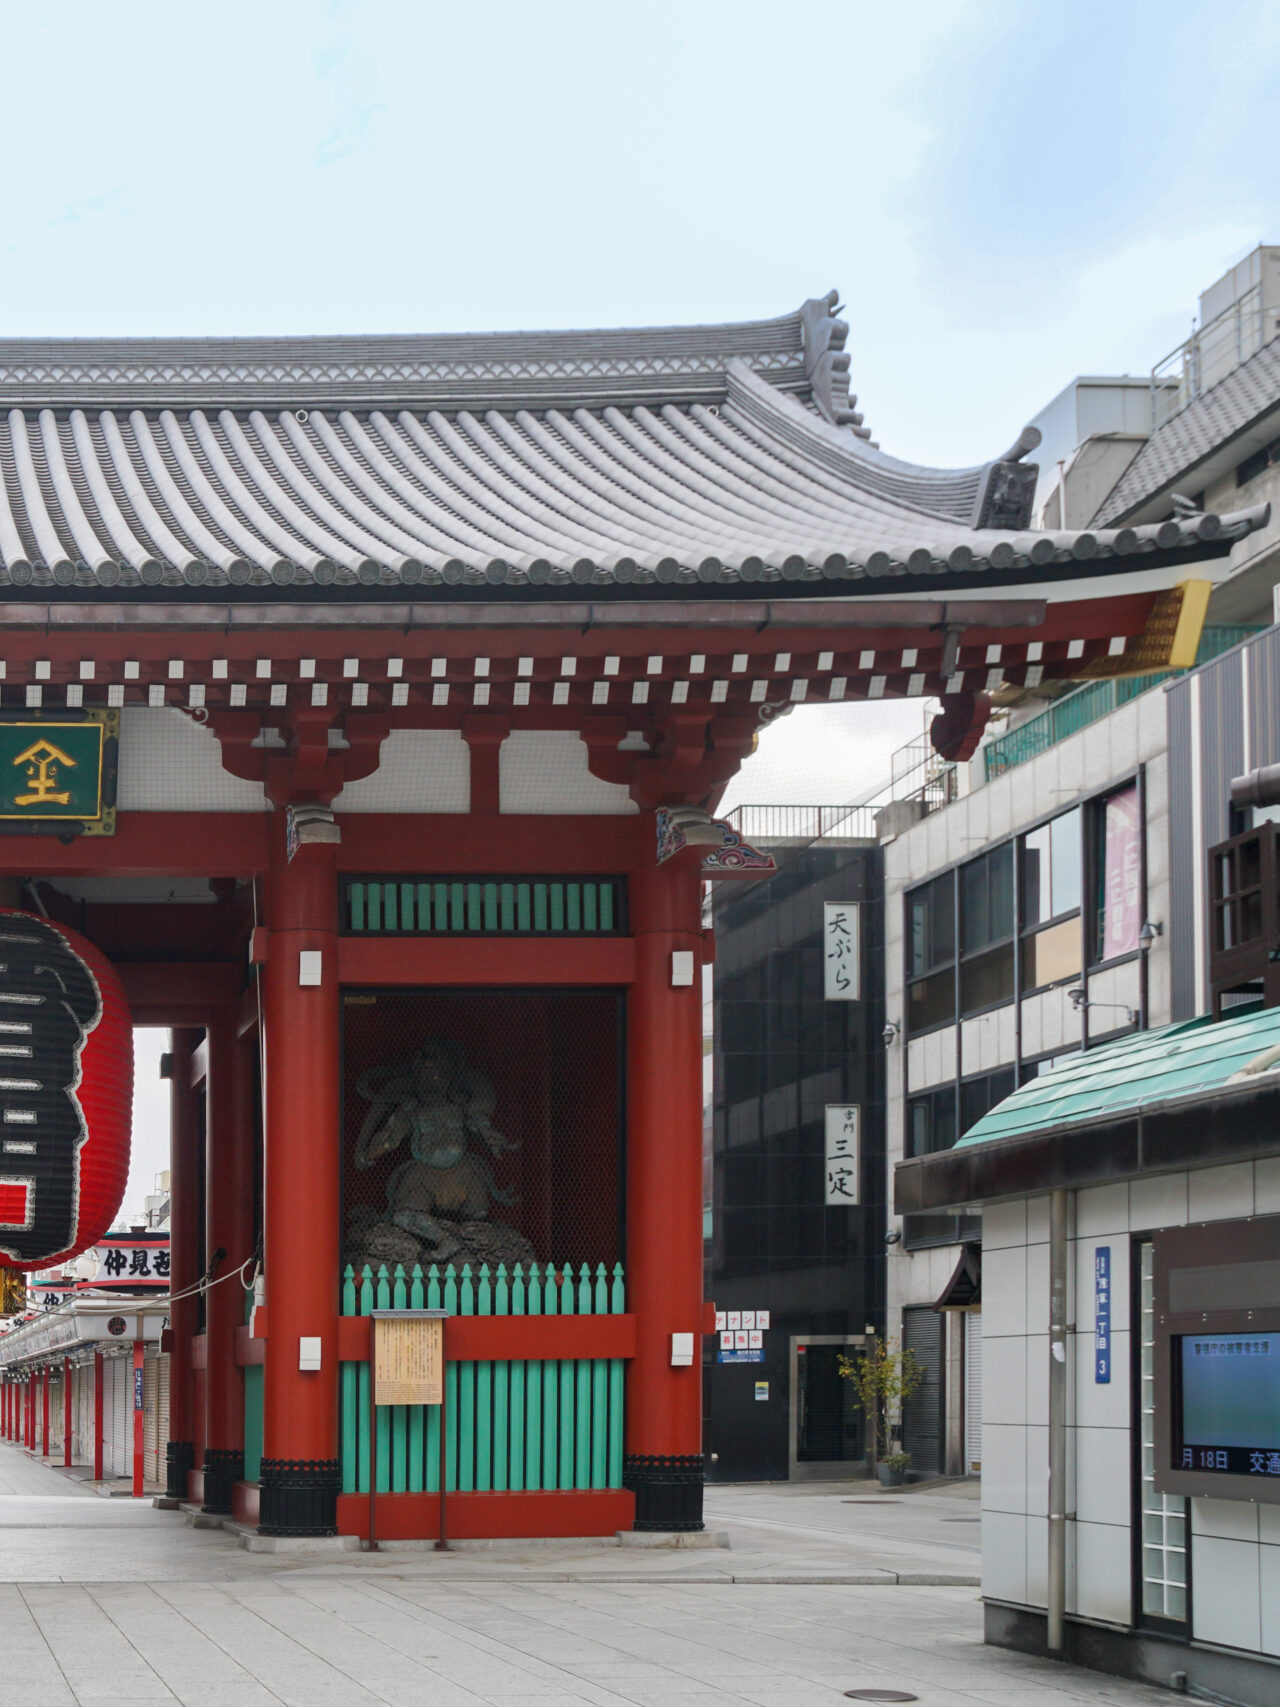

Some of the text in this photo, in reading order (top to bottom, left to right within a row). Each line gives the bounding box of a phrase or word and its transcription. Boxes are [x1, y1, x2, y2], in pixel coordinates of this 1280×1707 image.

[828, 912, 851, 991] 天ぷら
[827, 1139, 854, 1197] 三定
[716, 1316, 766, 1325] テナント
[1100, 1360, 1106, 1374] 3
